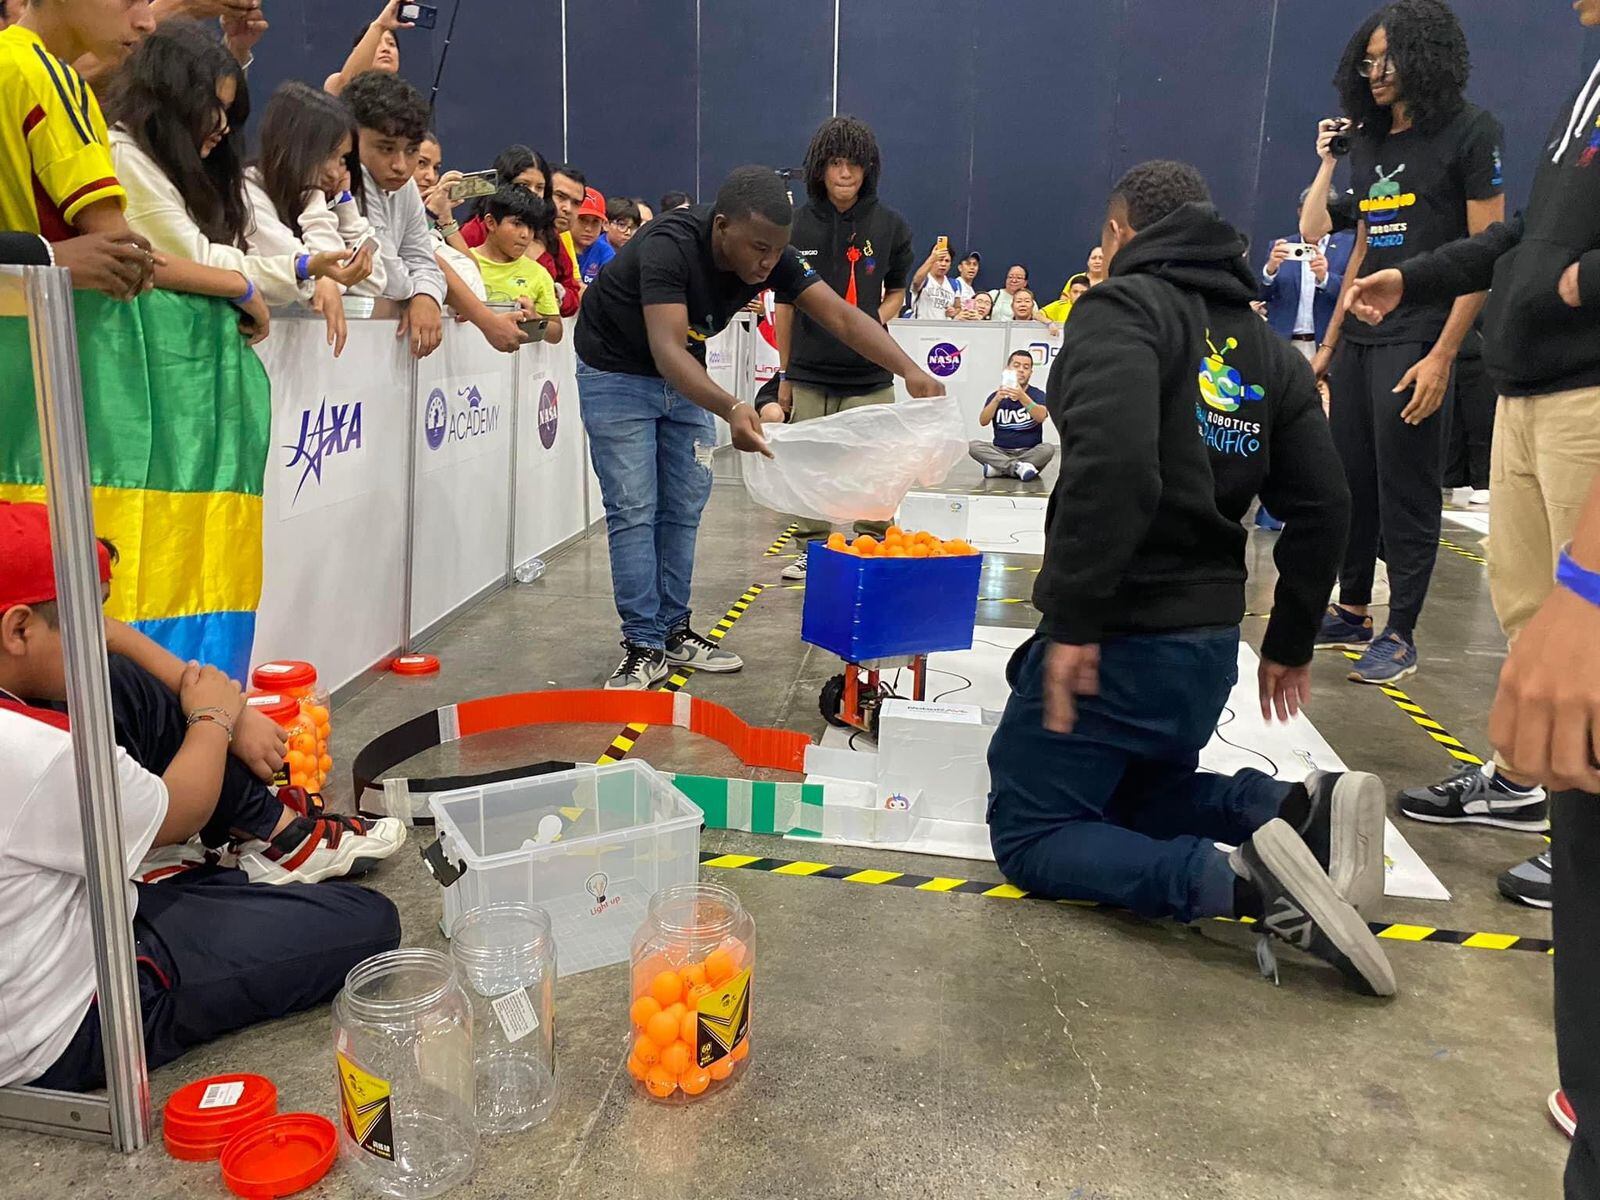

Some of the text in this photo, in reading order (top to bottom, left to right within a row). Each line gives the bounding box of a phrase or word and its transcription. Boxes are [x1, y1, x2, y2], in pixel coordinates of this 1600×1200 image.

[929, 355, 960, 364] NASA
[448, 405, 500, 443] ACADEMY
[1207, 411, 1261, 434] ROBOTICS
[282, 396, 361, 508] JAXA
